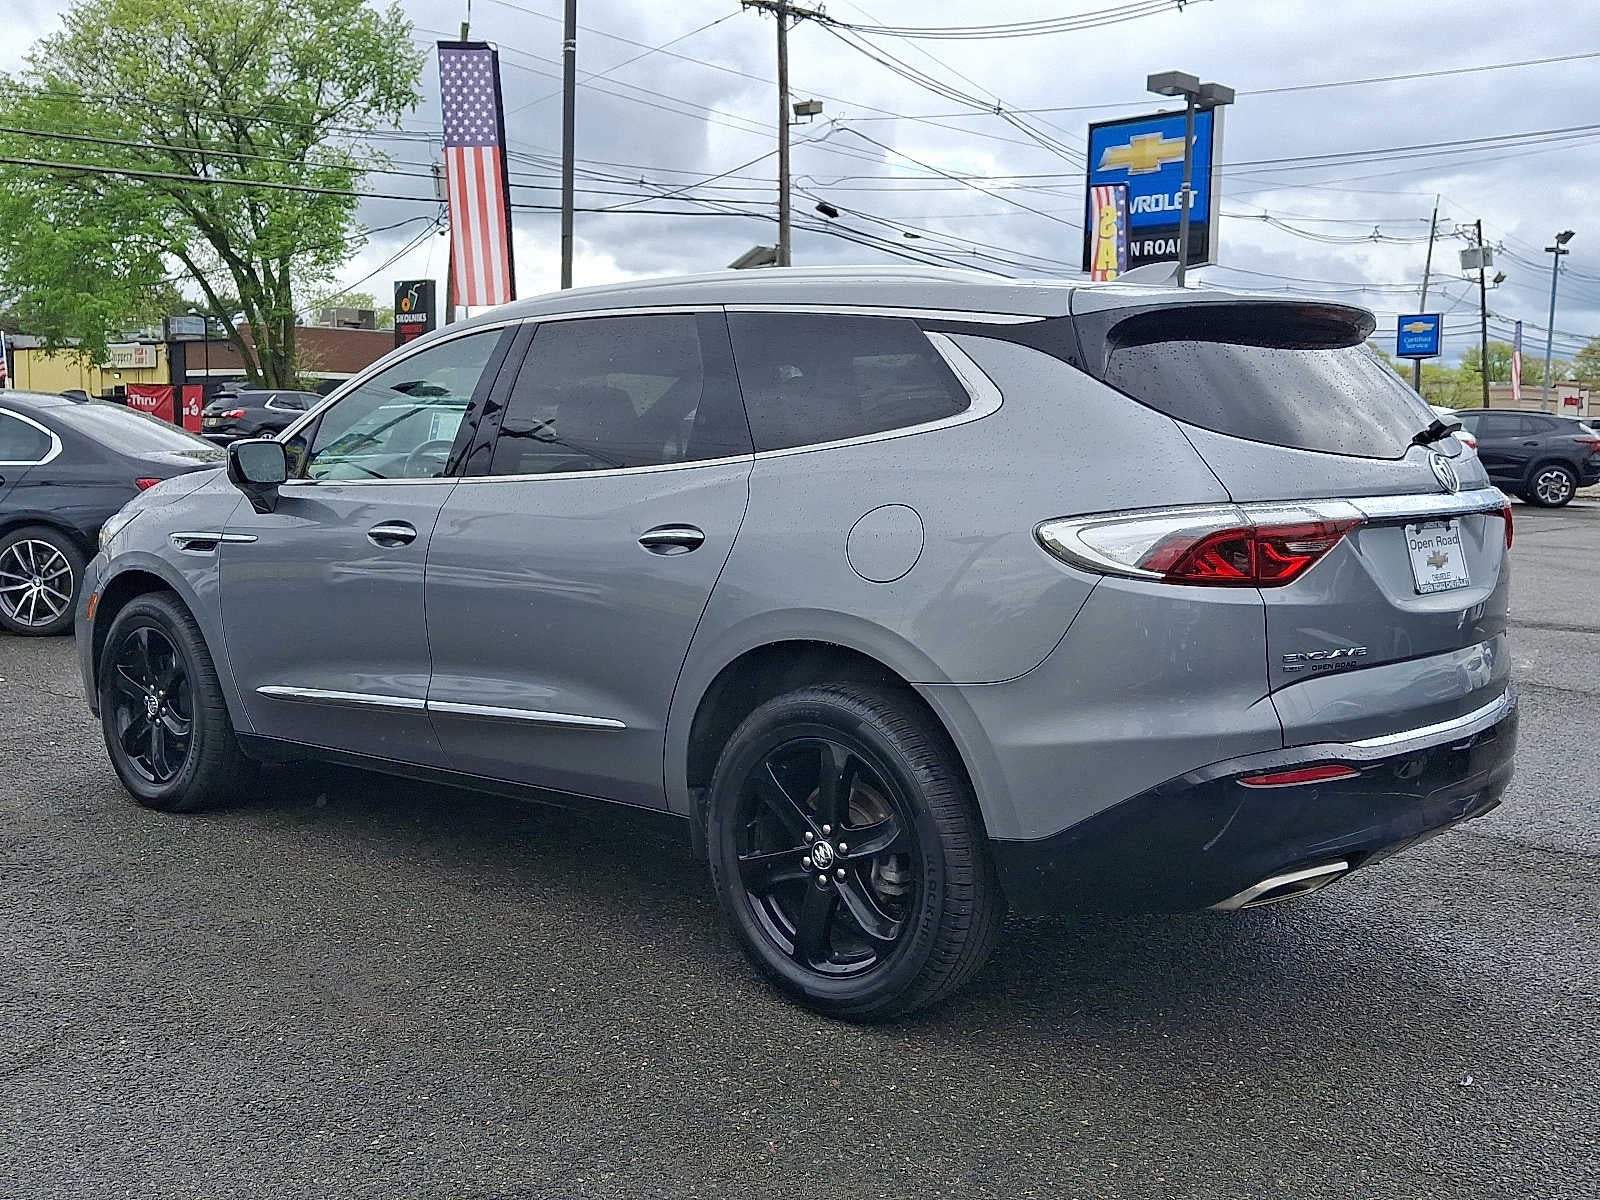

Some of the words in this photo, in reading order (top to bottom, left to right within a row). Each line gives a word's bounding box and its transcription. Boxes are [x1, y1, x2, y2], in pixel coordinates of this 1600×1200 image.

[1129, 191, 1198, 214] VROLET
[1409, 538, 1434, 552] Open
[1435, 535, 1459, 547] Road
[1282, 646, 1368, 663] ENCLAVE
[1311, 663, 1334, 672] OPEN
[1334, 661, 1357, 670] ROAD
